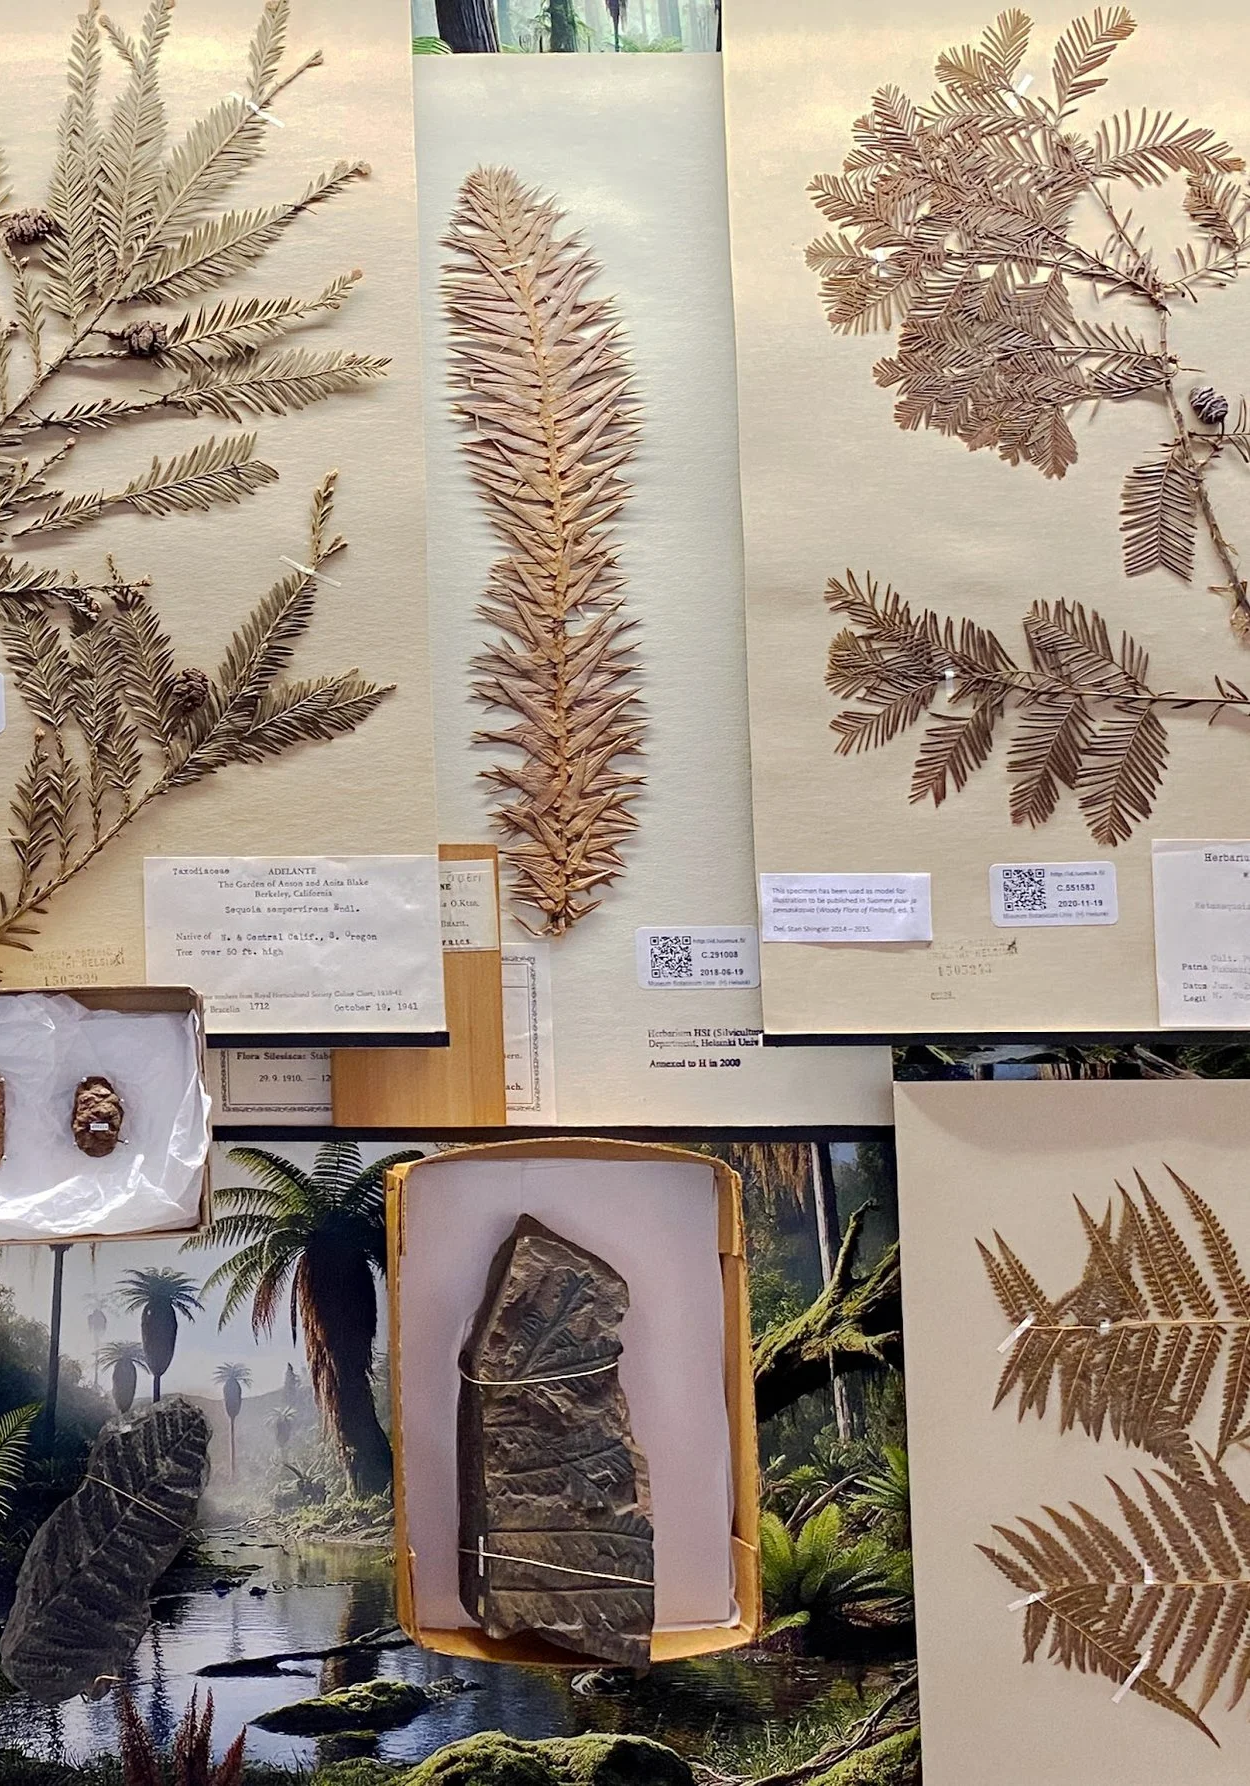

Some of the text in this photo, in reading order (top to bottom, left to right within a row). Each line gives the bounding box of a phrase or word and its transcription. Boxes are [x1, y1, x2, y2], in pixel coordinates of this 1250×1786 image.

[255, 891, 291, 899] Berkeley,
[1058, 900, 1103, 908] 2020-11-19
[225, 906, 261, 915] Sequoia
[176, 933, 201, 941] Native
[204, 932, 212, 940] of
[242, 948, 257, 956] ft.
[262, 948, 284, 957] high
[250, 1002, 418, 1012] 1712 October 1941
[701, 1039, 736, 1047] Helsinki
[237, 1052, 260, 1060] Flora
[650, 1060, 685, 1068] Annexed
[688, 1060, 696, 1068] to
[710, 1059, 717, 1067] in
